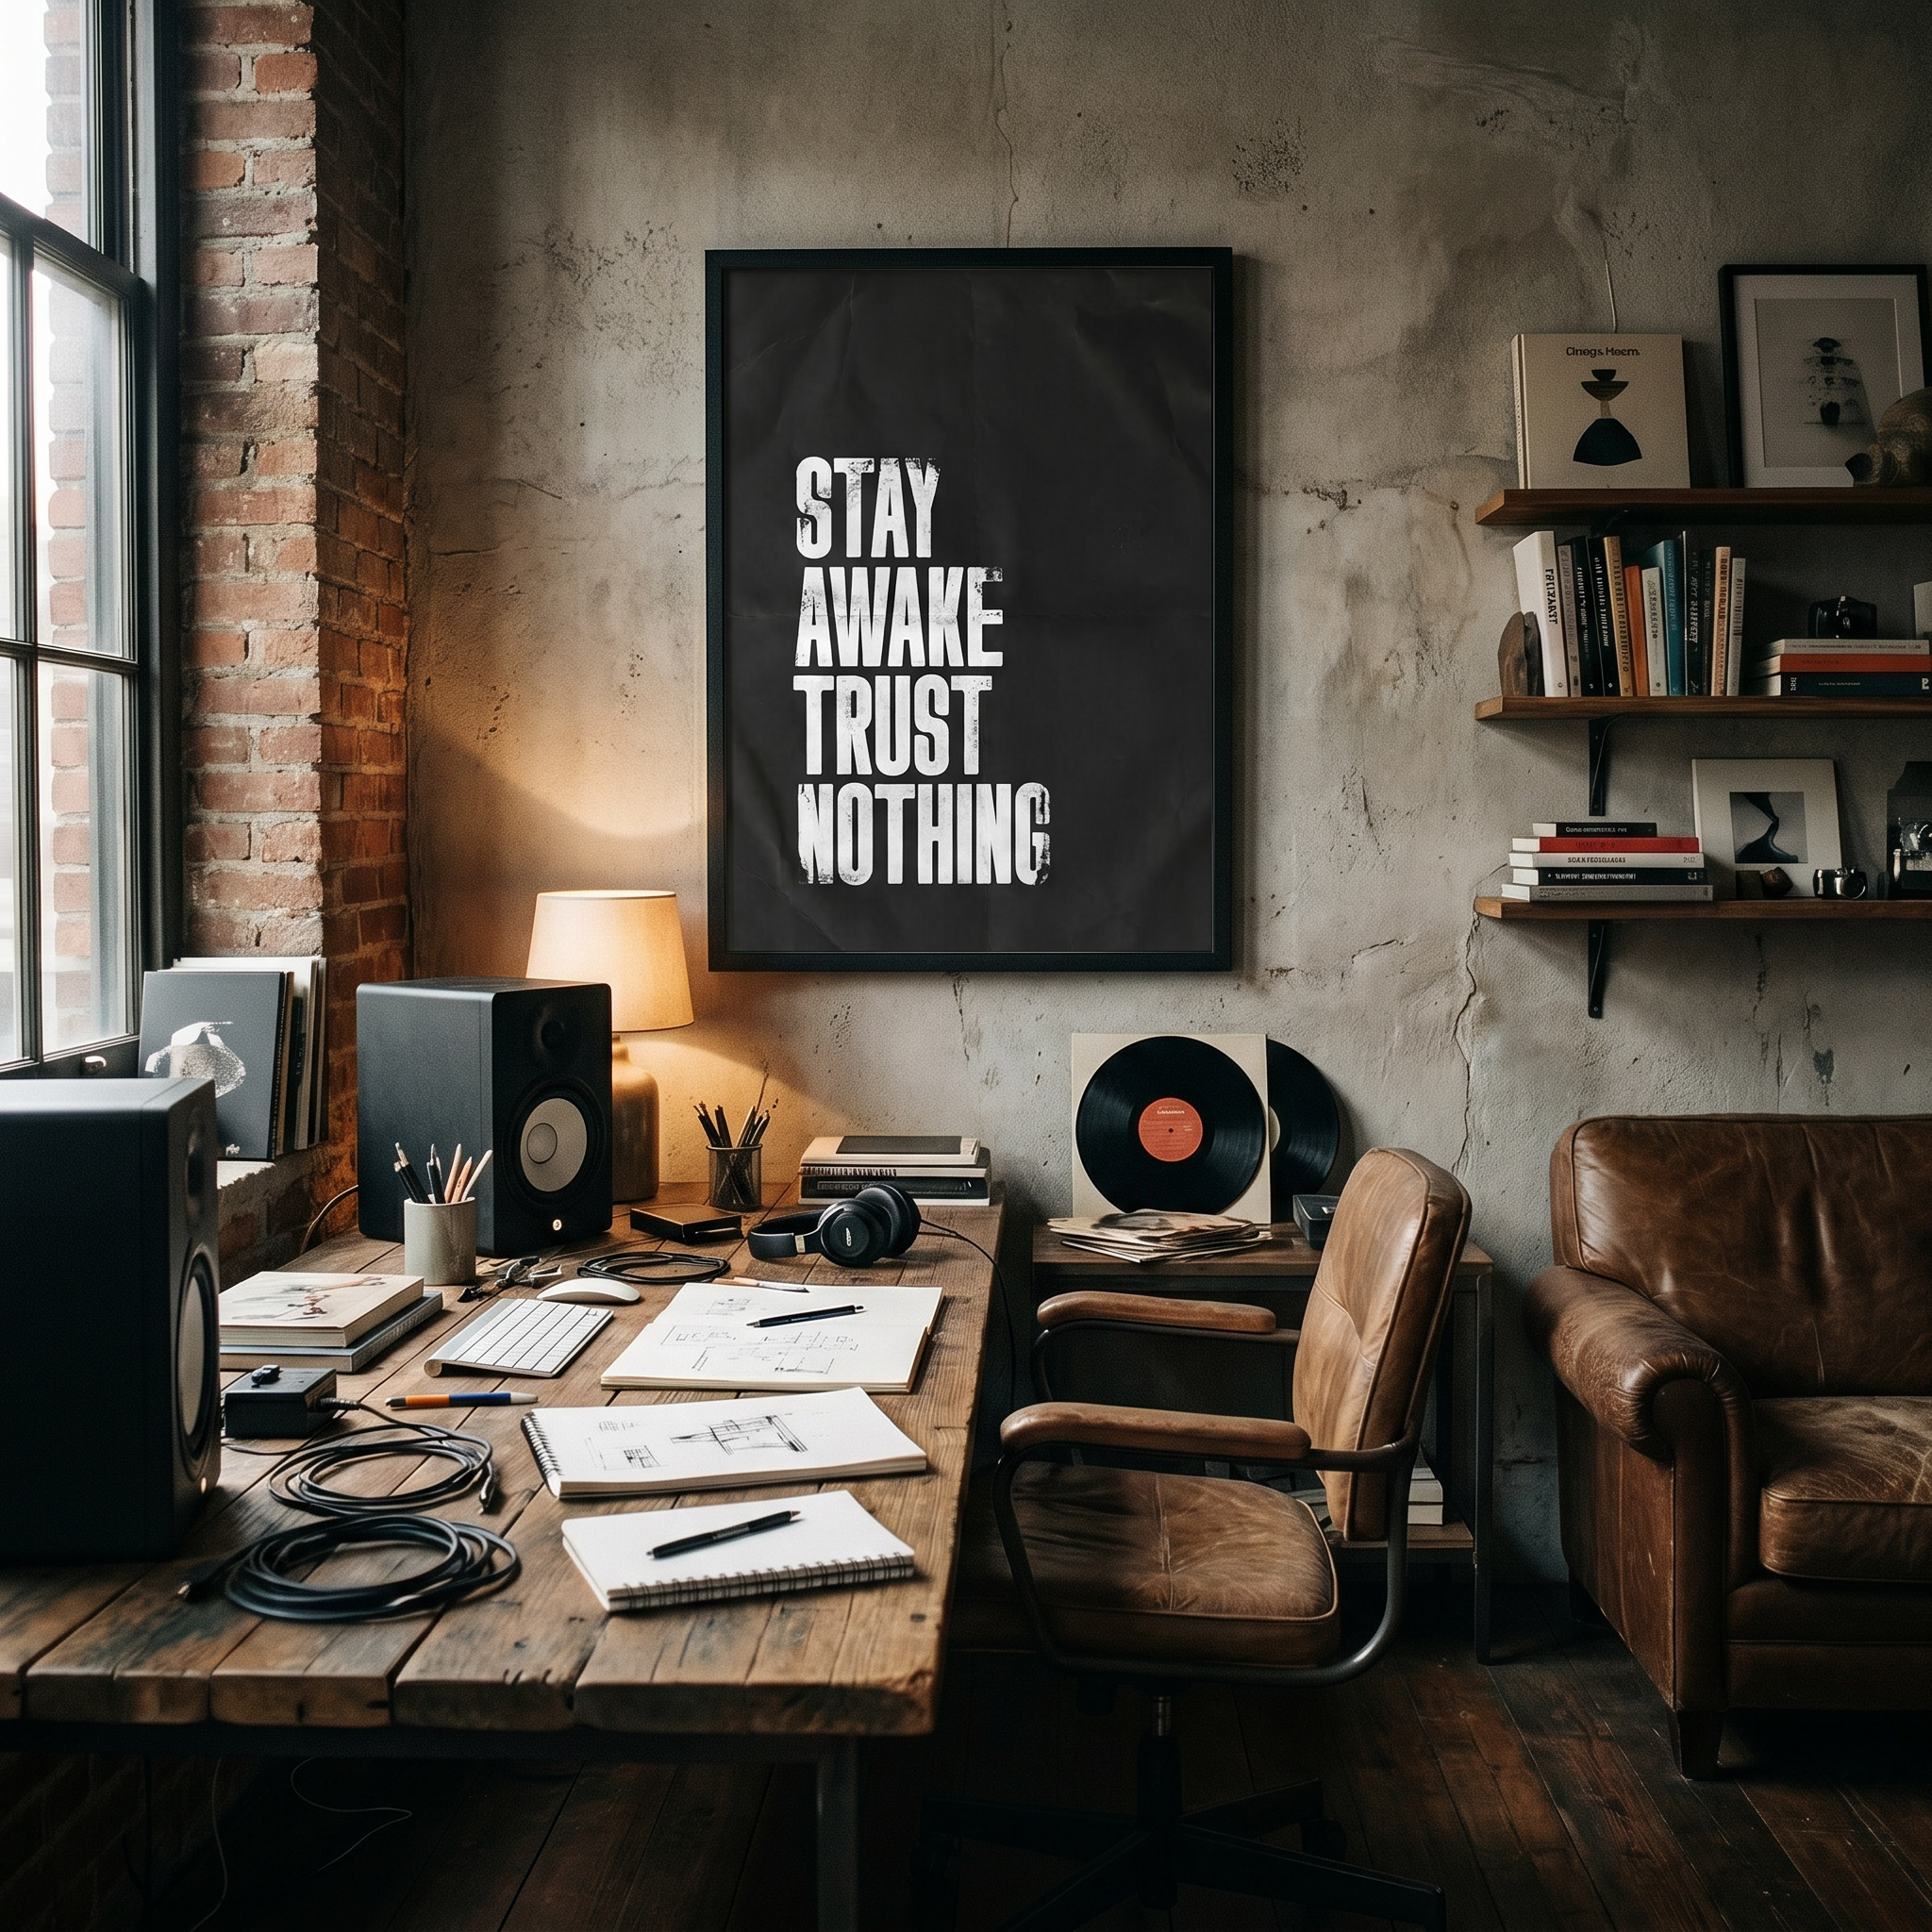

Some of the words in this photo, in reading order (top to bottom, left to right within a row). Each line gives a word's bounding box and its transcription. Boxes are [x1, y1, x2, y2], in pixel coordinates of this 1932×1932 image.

[796, 457, 941, 558] STAY
[795, 567, 1003, 667] AWAKE
[793, 675, 992, 775] TRUST
[798, 782, 1050, 885] NOTHING
